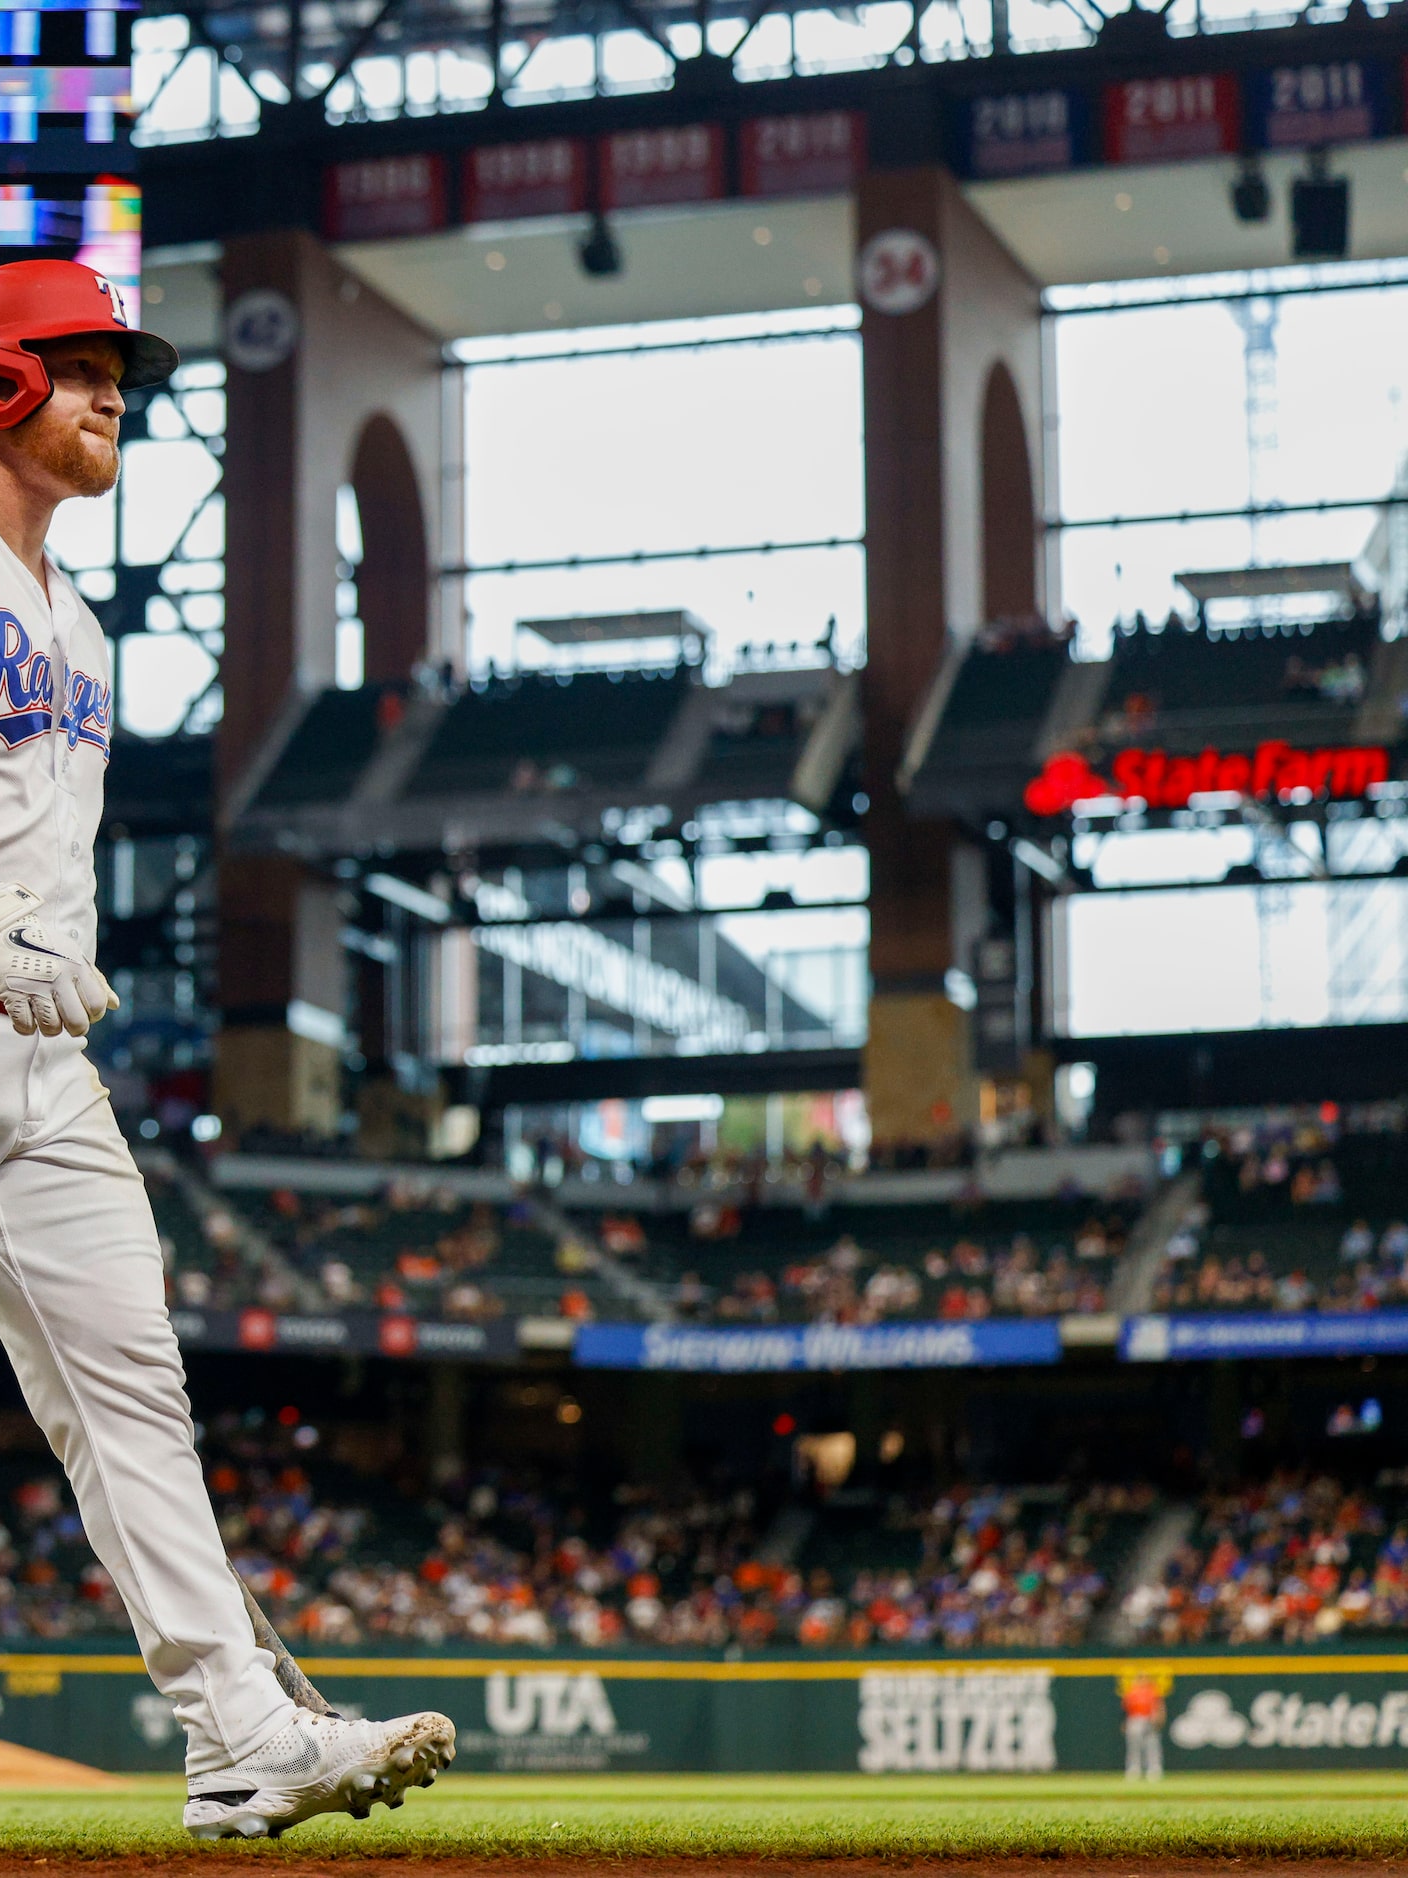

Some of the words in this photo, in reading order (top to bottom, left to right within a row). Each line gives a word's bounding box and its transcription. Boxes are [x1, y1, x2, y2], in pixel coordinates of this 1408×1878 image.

[94, 275, 127, 328] T
[484, 1670, 617, 1735] UTA
[857, 1699, 1057, 1771] SELTZER
